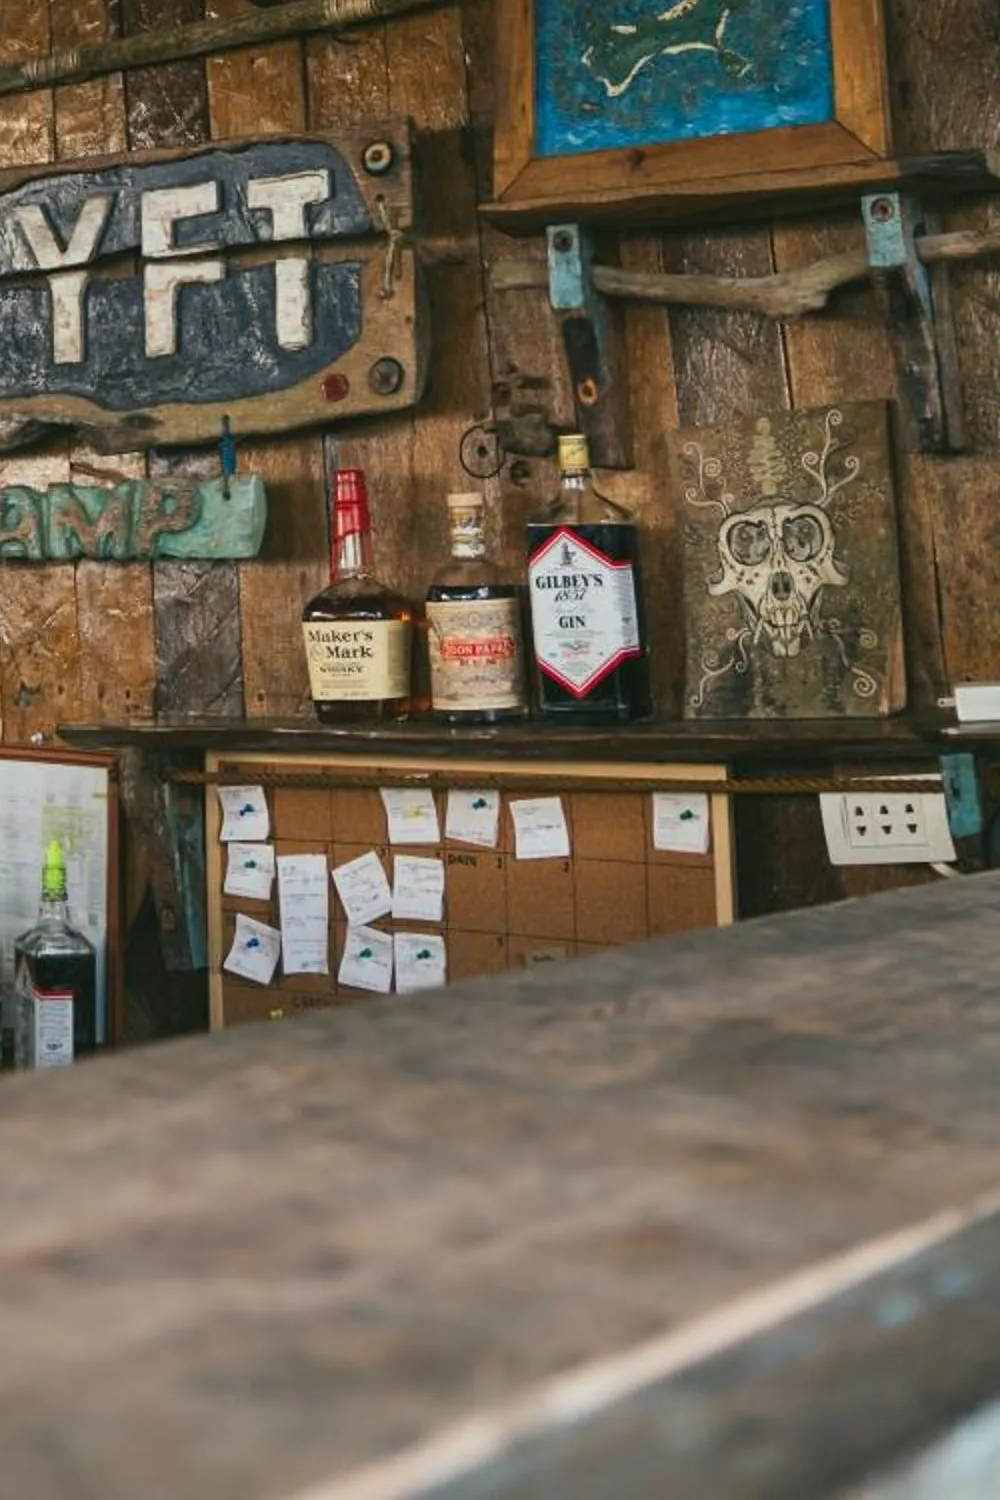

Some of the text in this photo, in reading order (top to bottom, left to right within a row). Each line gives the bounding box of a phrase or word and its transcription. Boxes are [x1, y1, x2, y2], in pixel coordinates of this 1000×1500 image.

[535, 573, 604, 590] GILBEY'S
[558, 615, 587, 629] GIN
[308, 628, 374, 643] Maker's
[325, 645, 374, 659] Mark
